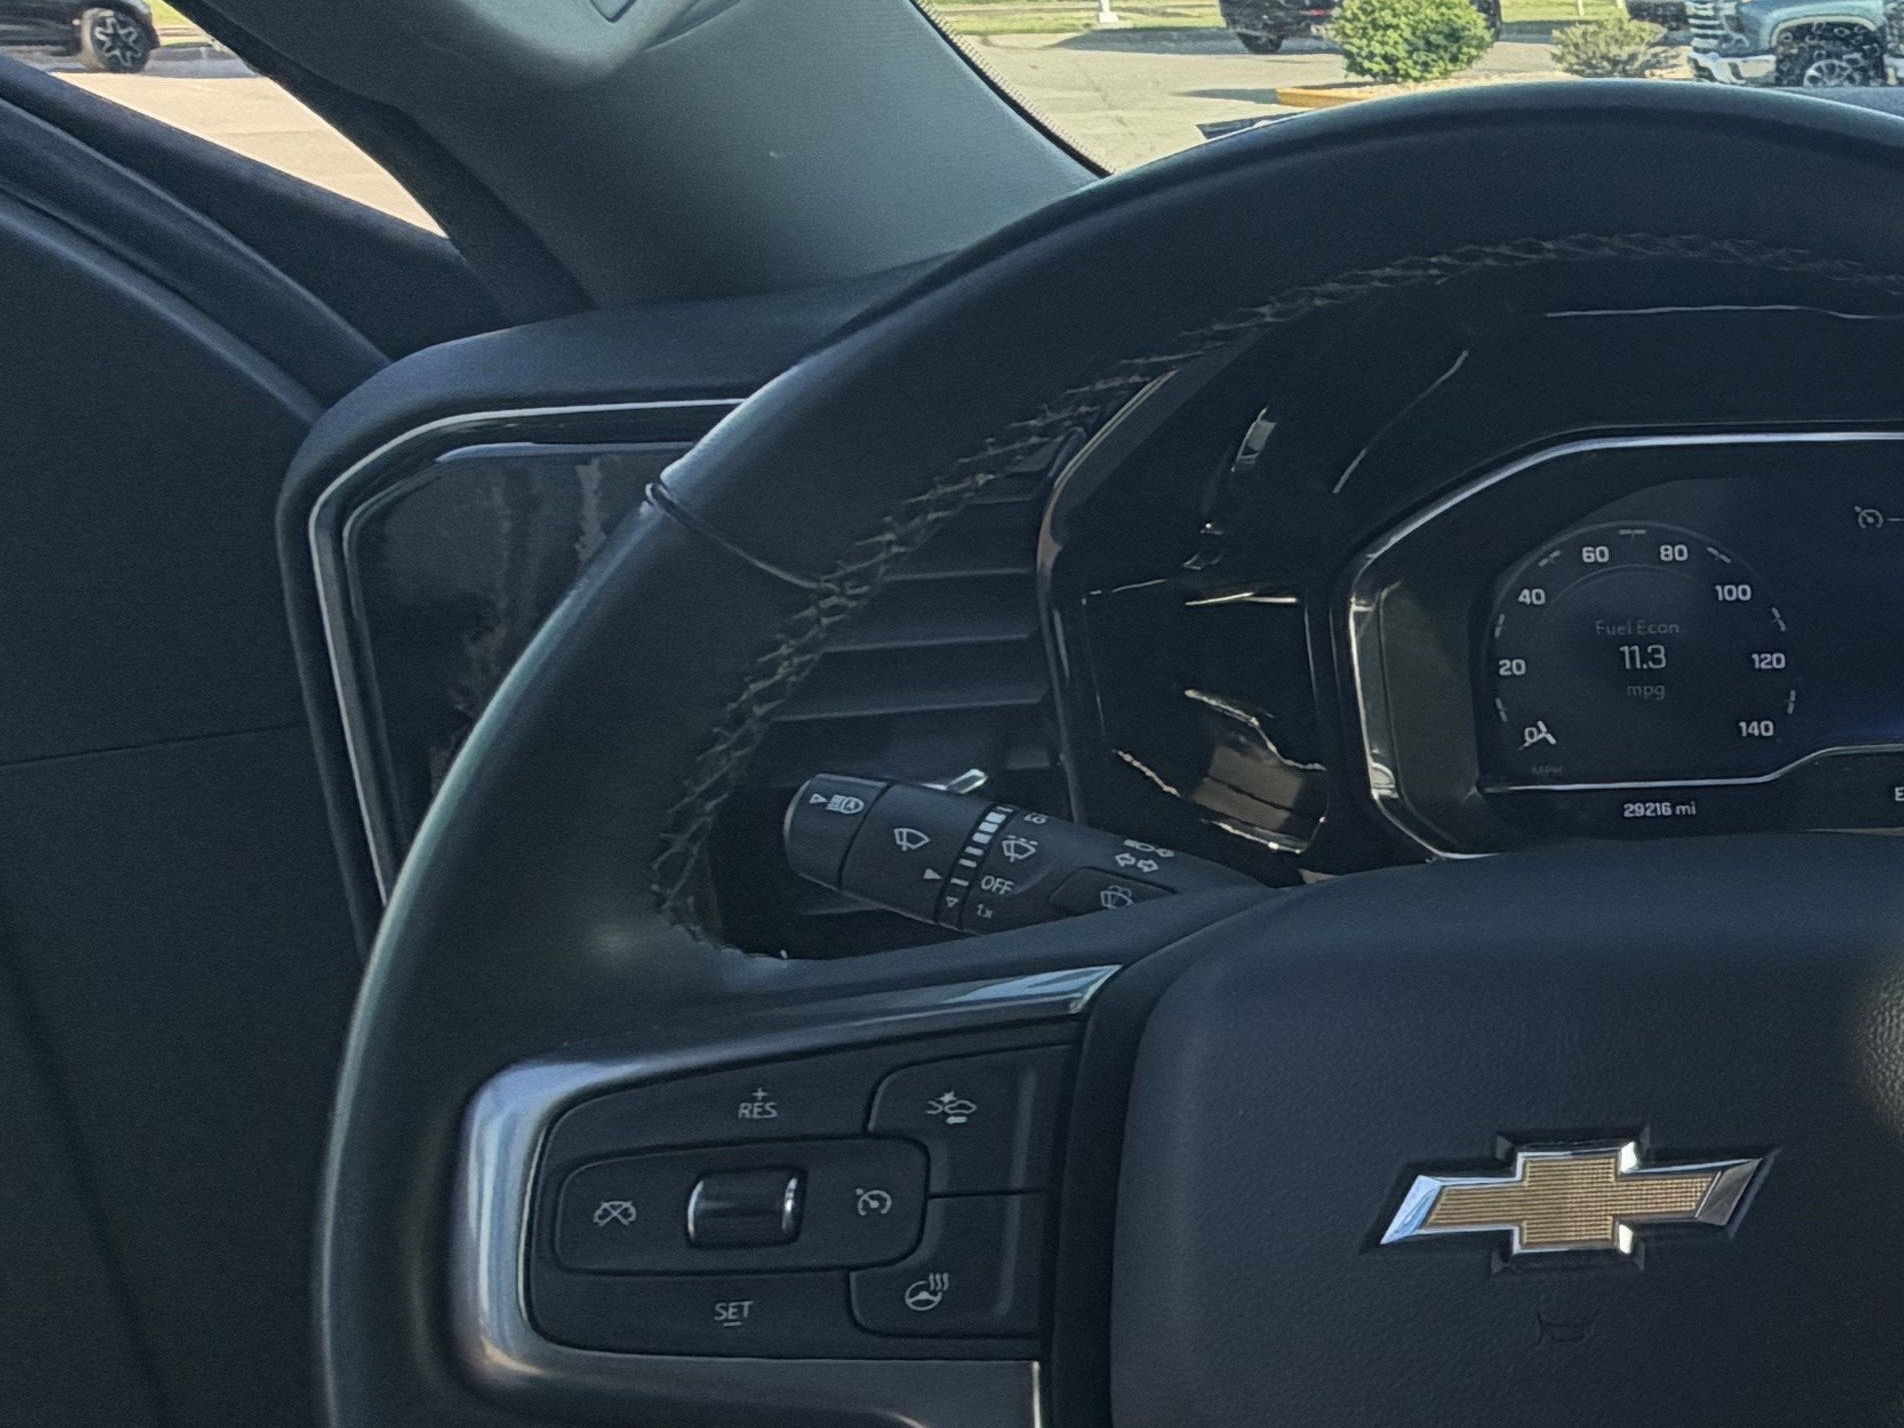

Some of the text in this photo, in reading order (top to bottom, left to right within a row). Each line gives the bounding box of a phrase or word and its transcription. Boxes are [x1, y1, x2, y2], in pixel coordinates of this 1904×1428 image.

[1583, 547, 1608, 562] 60
[1661, 545, 1687, 560] 80
[1519, 589, 1545, 604] 40
[1716, 585, 1751, 600] 100
[1596, 620, 1680, 635] Fuel Econ
[1620, 645, 1666, 669] 11.3
[1753, 654, 1785, 668] 120
[1499, 659, 1526, 675] 20
[1627, 682, 1665, 700] mpg
[1740, 721, 1773, 736] 140
[1894, 786, 1904, 803] E
[1624, 801, 1696, 817] 29216 mi
[981, 875, 1014, 894] OFF
[739, 1099, 777, 1118] RES
[715, 1301, 752, 1320] SET
